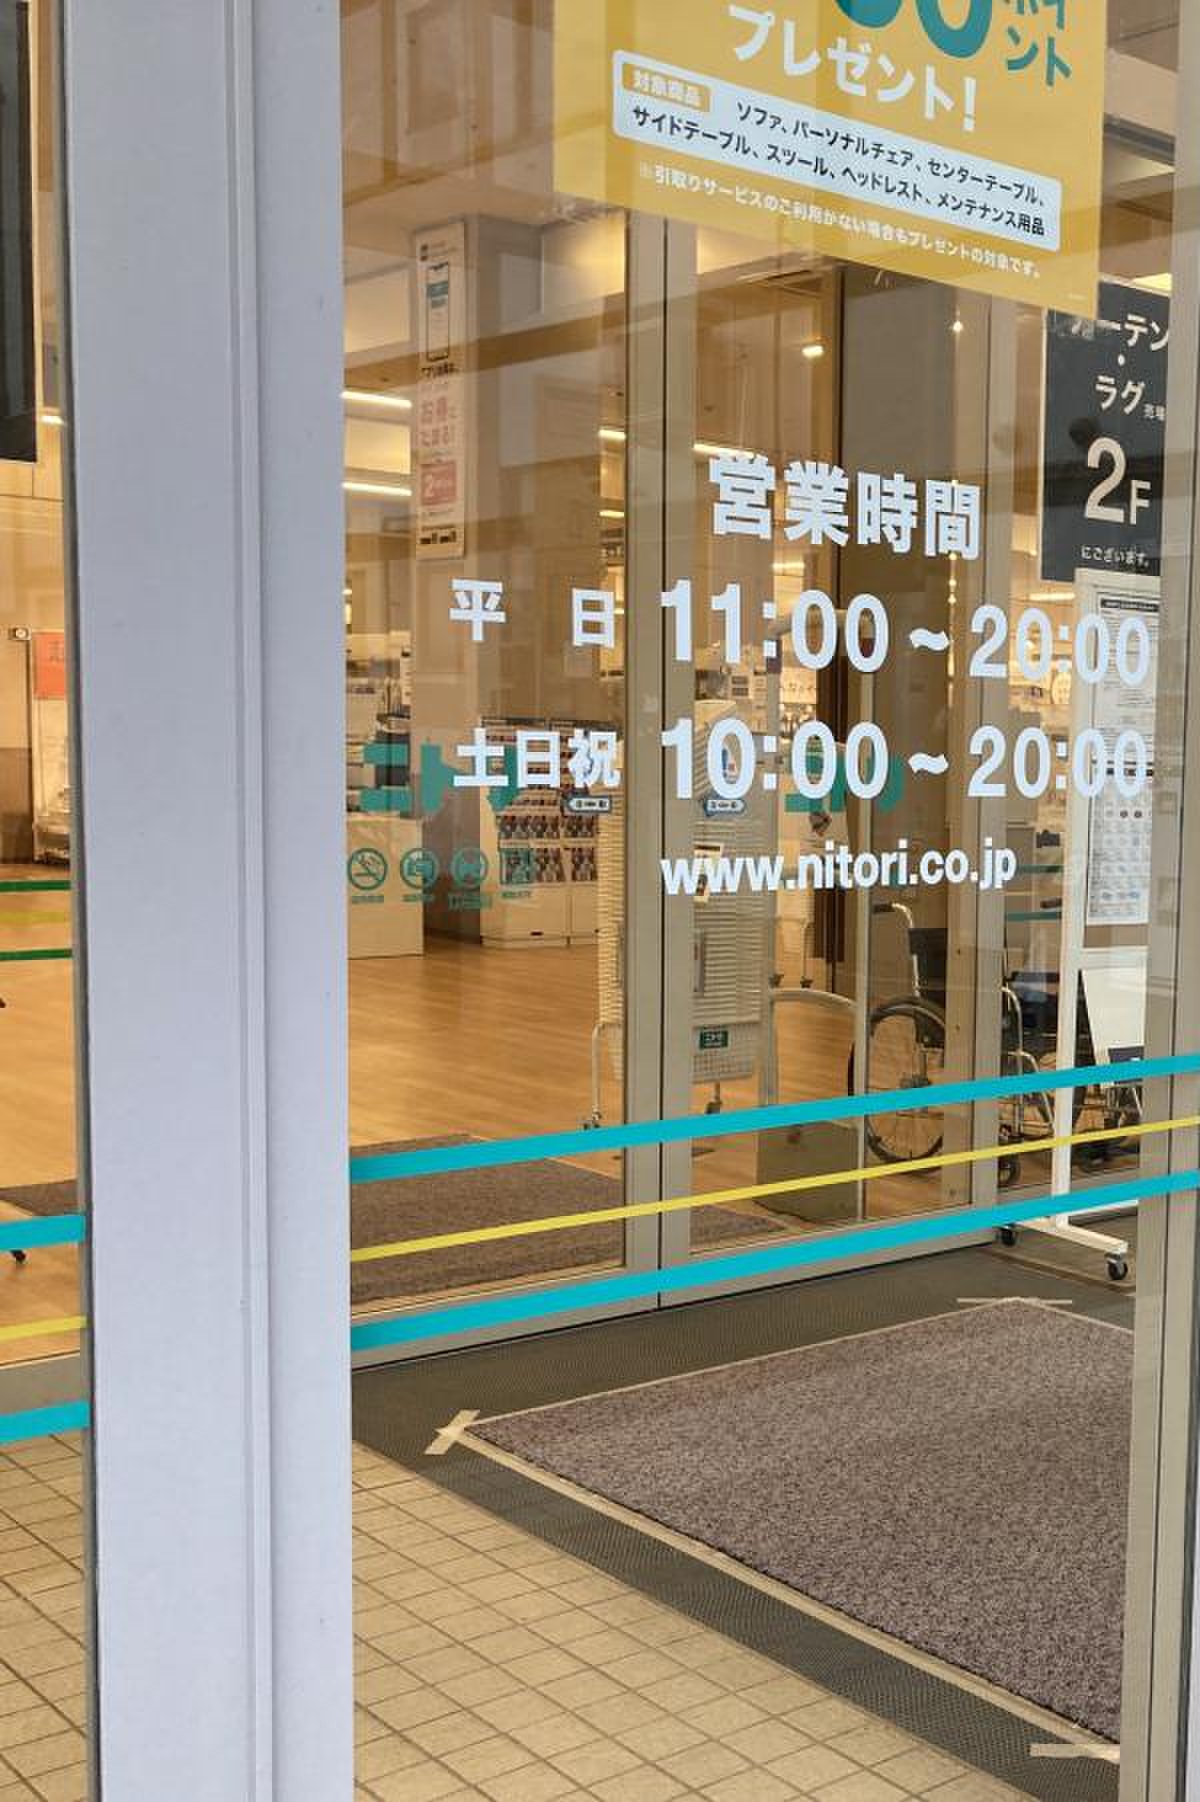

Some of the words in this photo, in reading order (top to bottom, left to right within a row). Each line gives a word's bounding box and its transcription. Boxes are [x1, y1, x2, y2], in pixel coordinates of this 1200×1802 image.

[708, 450, 980, 562] 営業時間
[1084, 436, 1151, 525] 2F
[453, 727, 622, 788] 土日祝
[660, 838, 1016, 896] www.nitori.co.jp
